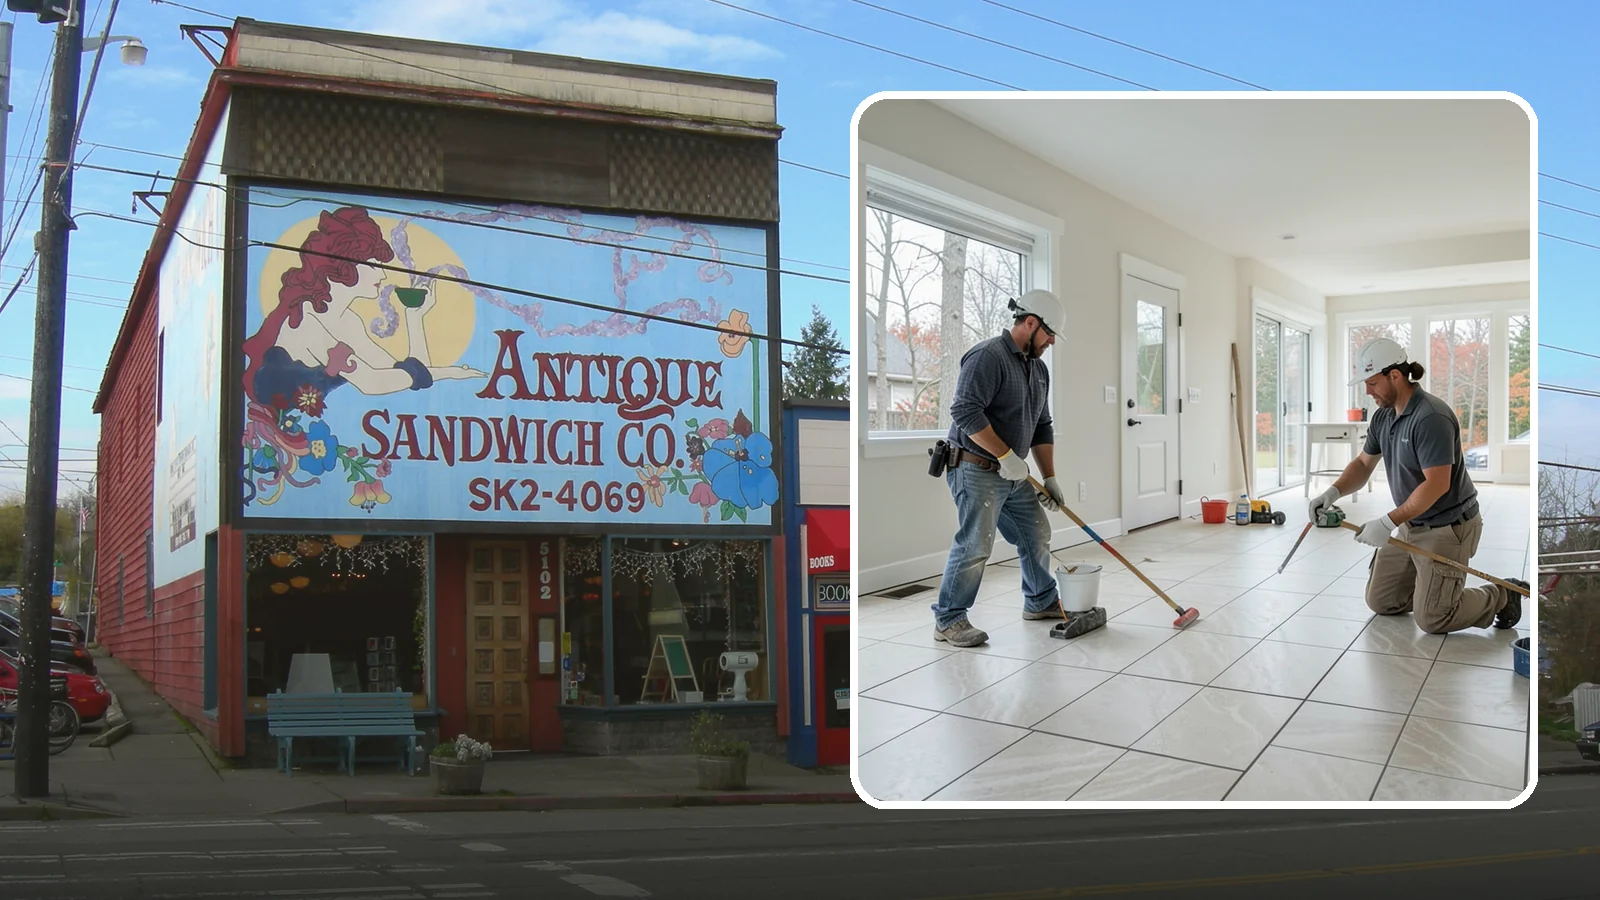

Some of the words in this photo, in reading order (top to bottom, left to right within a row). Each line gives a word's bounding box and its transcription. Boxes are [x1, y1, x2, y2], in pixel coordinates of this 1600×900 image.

[476, 329, 724, 420] ANTIQUE
[362, 409, 604, 467] SANDWICH
[617, 422, 685, 468] CO.
[469, 477, 646, 513] SK2-4069
[540, 542, 551, 599] 5102
[809, 555, 835, 569] BOOKS
